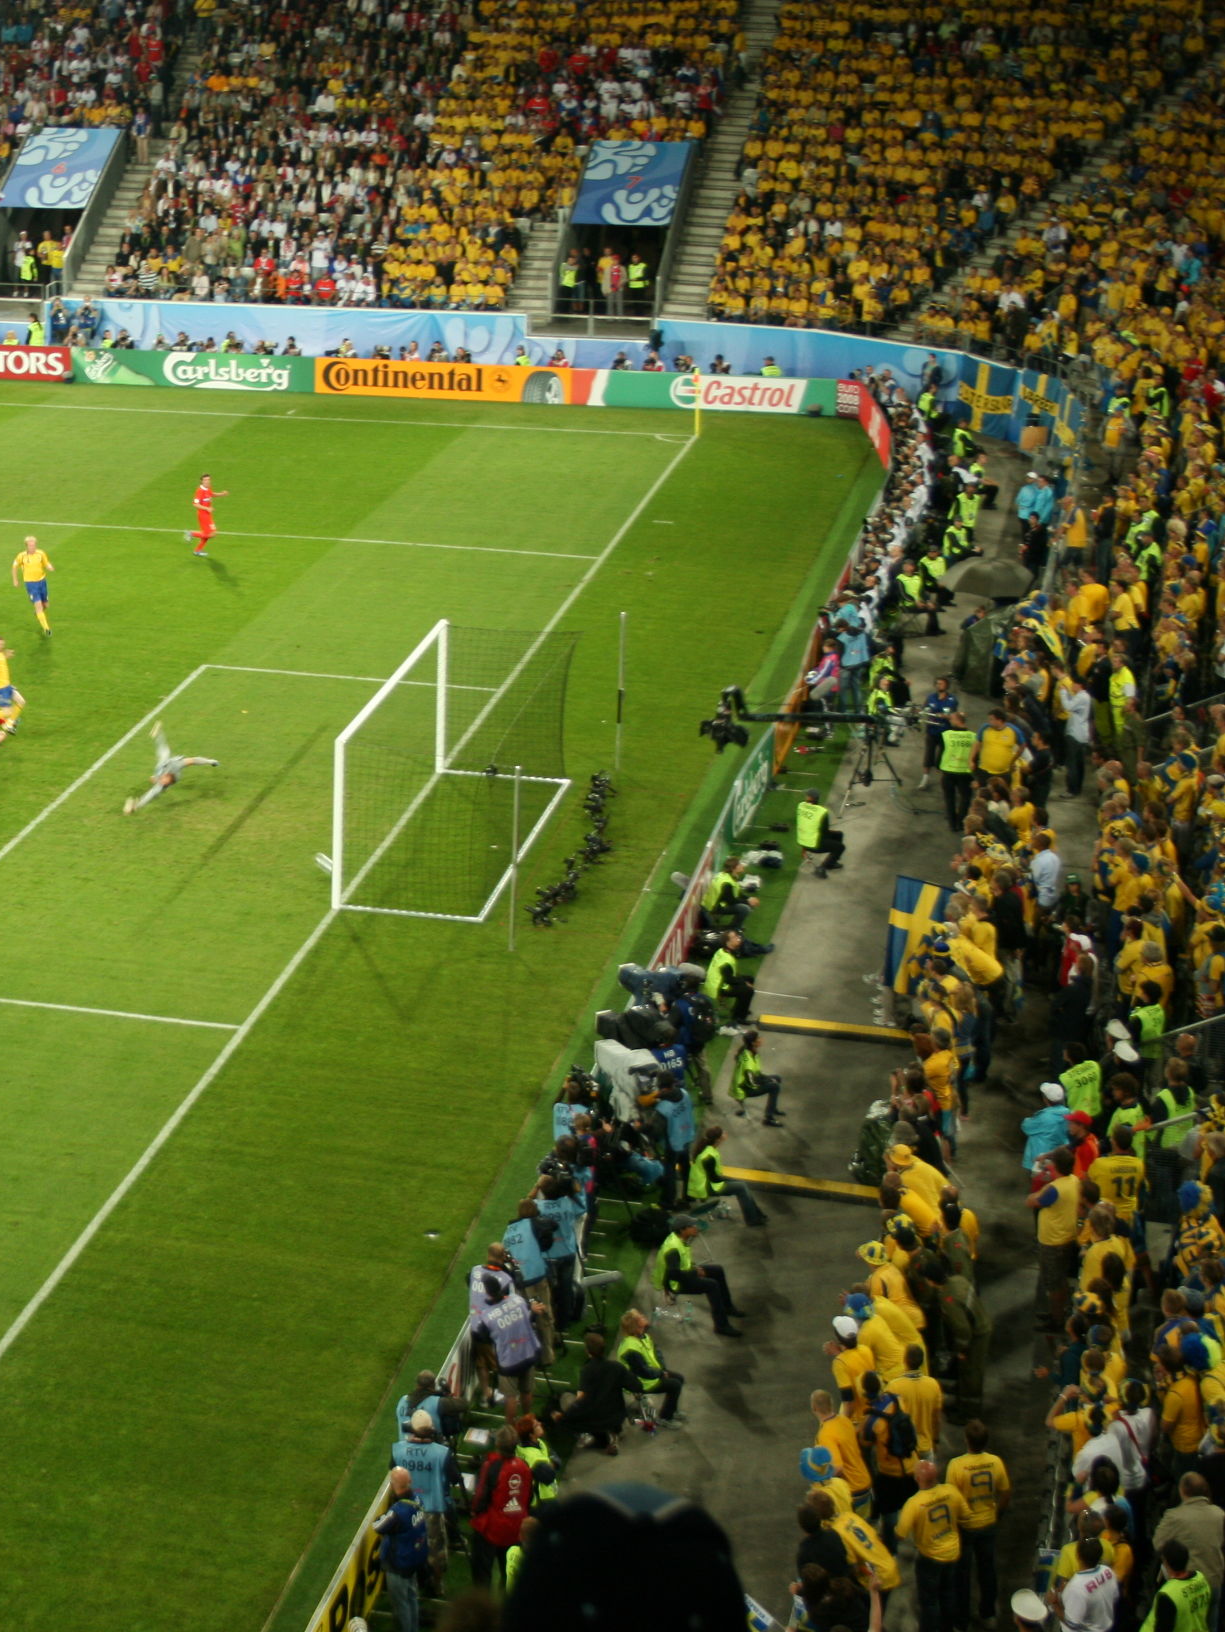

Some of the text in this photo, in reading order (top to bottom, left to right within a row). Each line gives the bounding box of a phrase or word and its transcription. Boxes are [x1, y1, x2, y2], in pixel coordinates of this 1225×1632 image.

[625, 176, 644, 189] 7
[163, 351, 291, 392] Carlsberg
[322, 360, 484, 392] Continental
[702, 380, 796, 409] Castrol
[1112, 1175, 1136, 1198] 11
[406, 1446, 428, 1457] RTV
